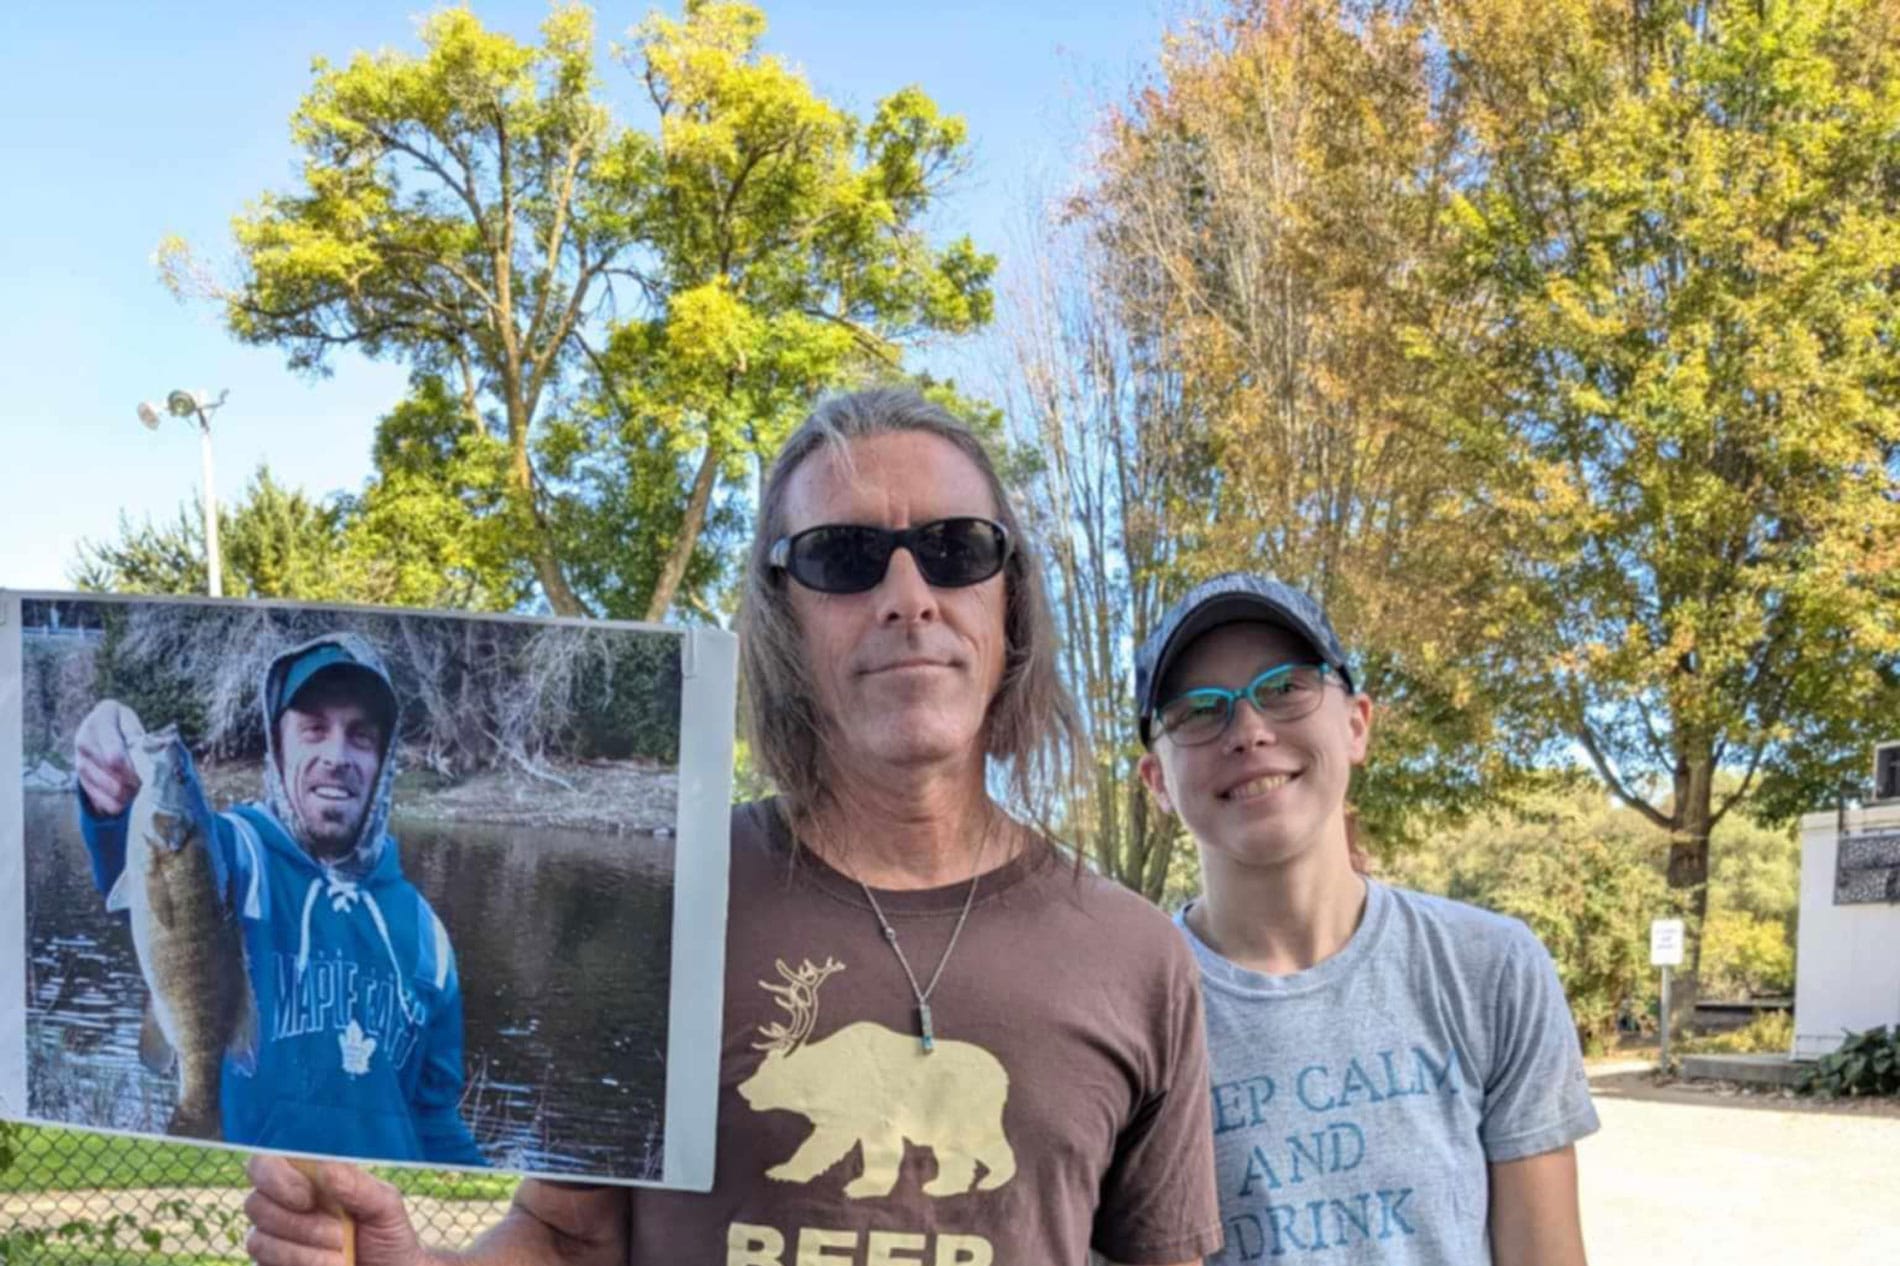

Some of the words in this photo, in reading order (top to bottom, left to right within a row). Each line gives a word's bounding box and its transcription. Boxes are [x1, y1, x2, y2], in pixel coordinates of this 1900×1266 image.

[271, 951, 359, 1042] MAPLE
[1296, 1046, 1460, 1112] CALM
[1238, 1122, 1366, 1197] AND
[1229, 1188, 1416, 1263] DRINK
